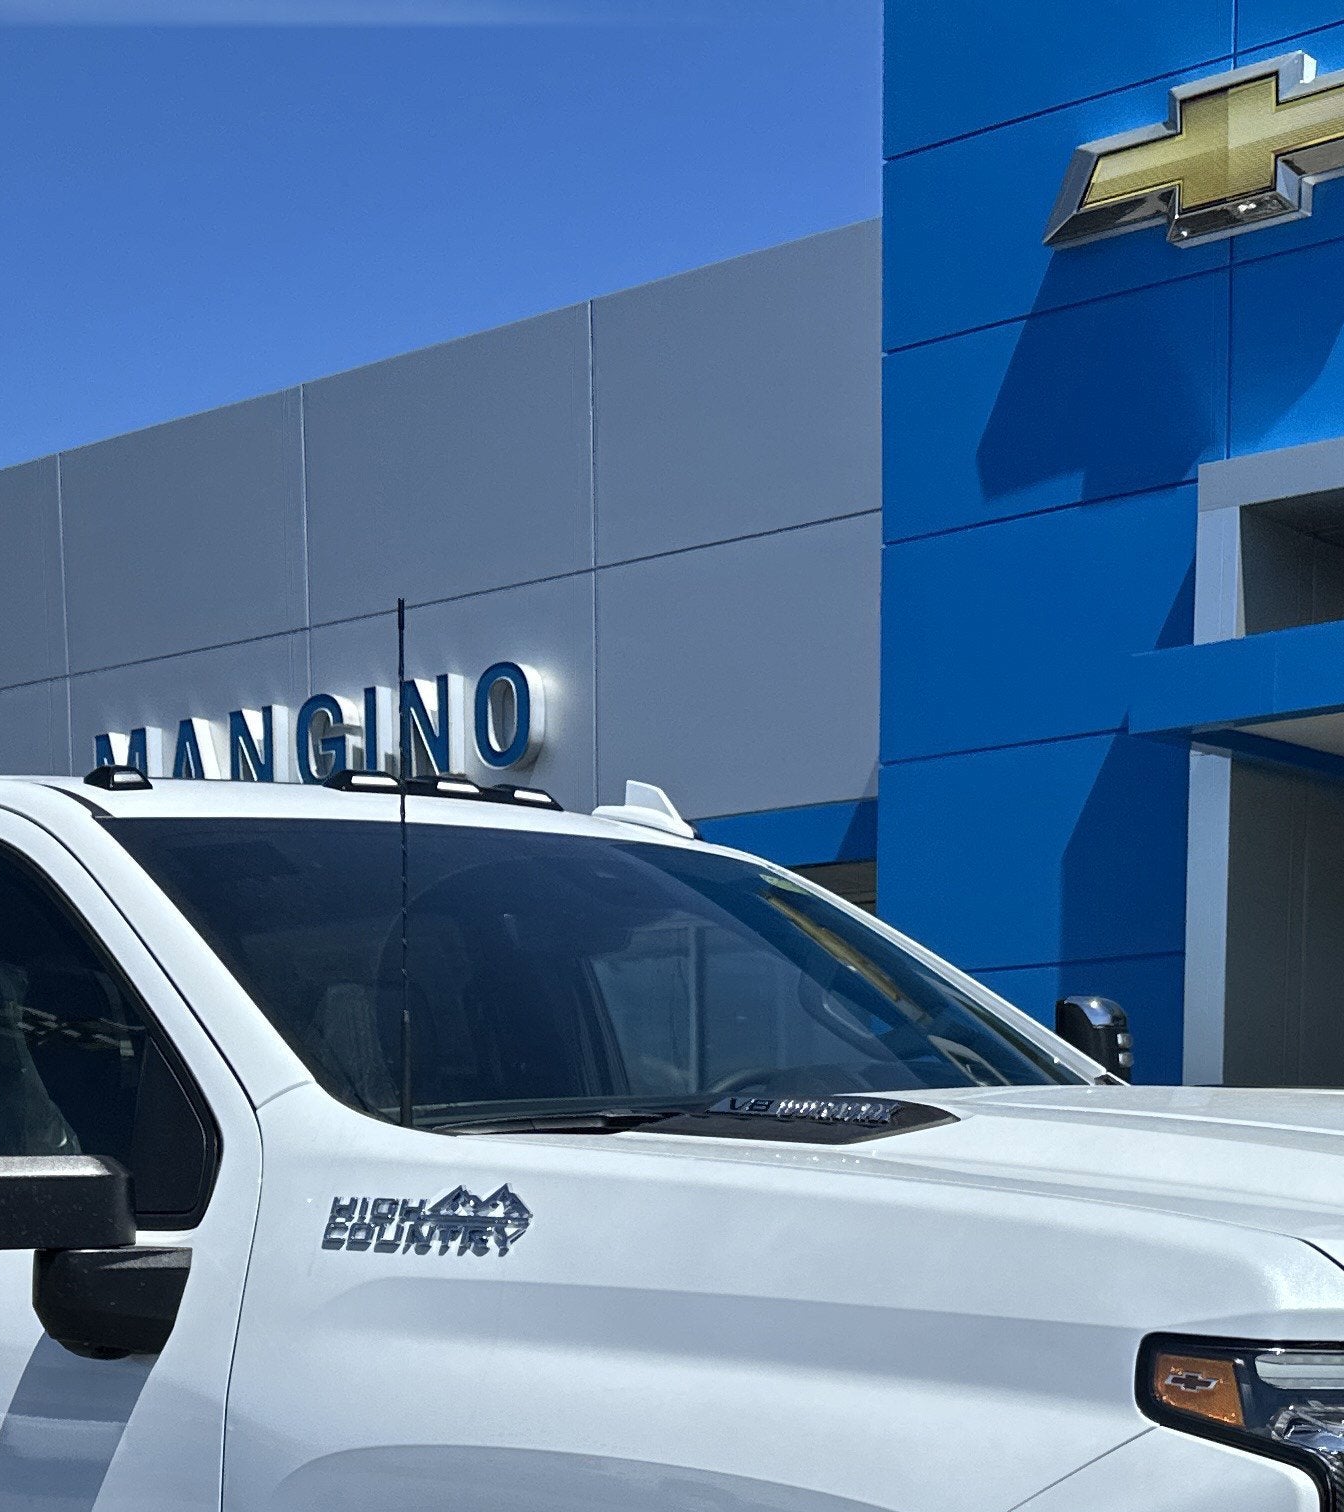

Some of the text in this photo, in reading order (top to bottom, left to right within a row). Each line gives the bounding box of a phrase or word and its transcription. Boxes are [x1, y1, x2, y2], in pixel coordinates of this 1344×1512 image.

[93, 660, 546, 784] MANGINO
[324, 1196, 432, 1226] HIGH
[320, 1219, 530, 1258] COUNTRY
